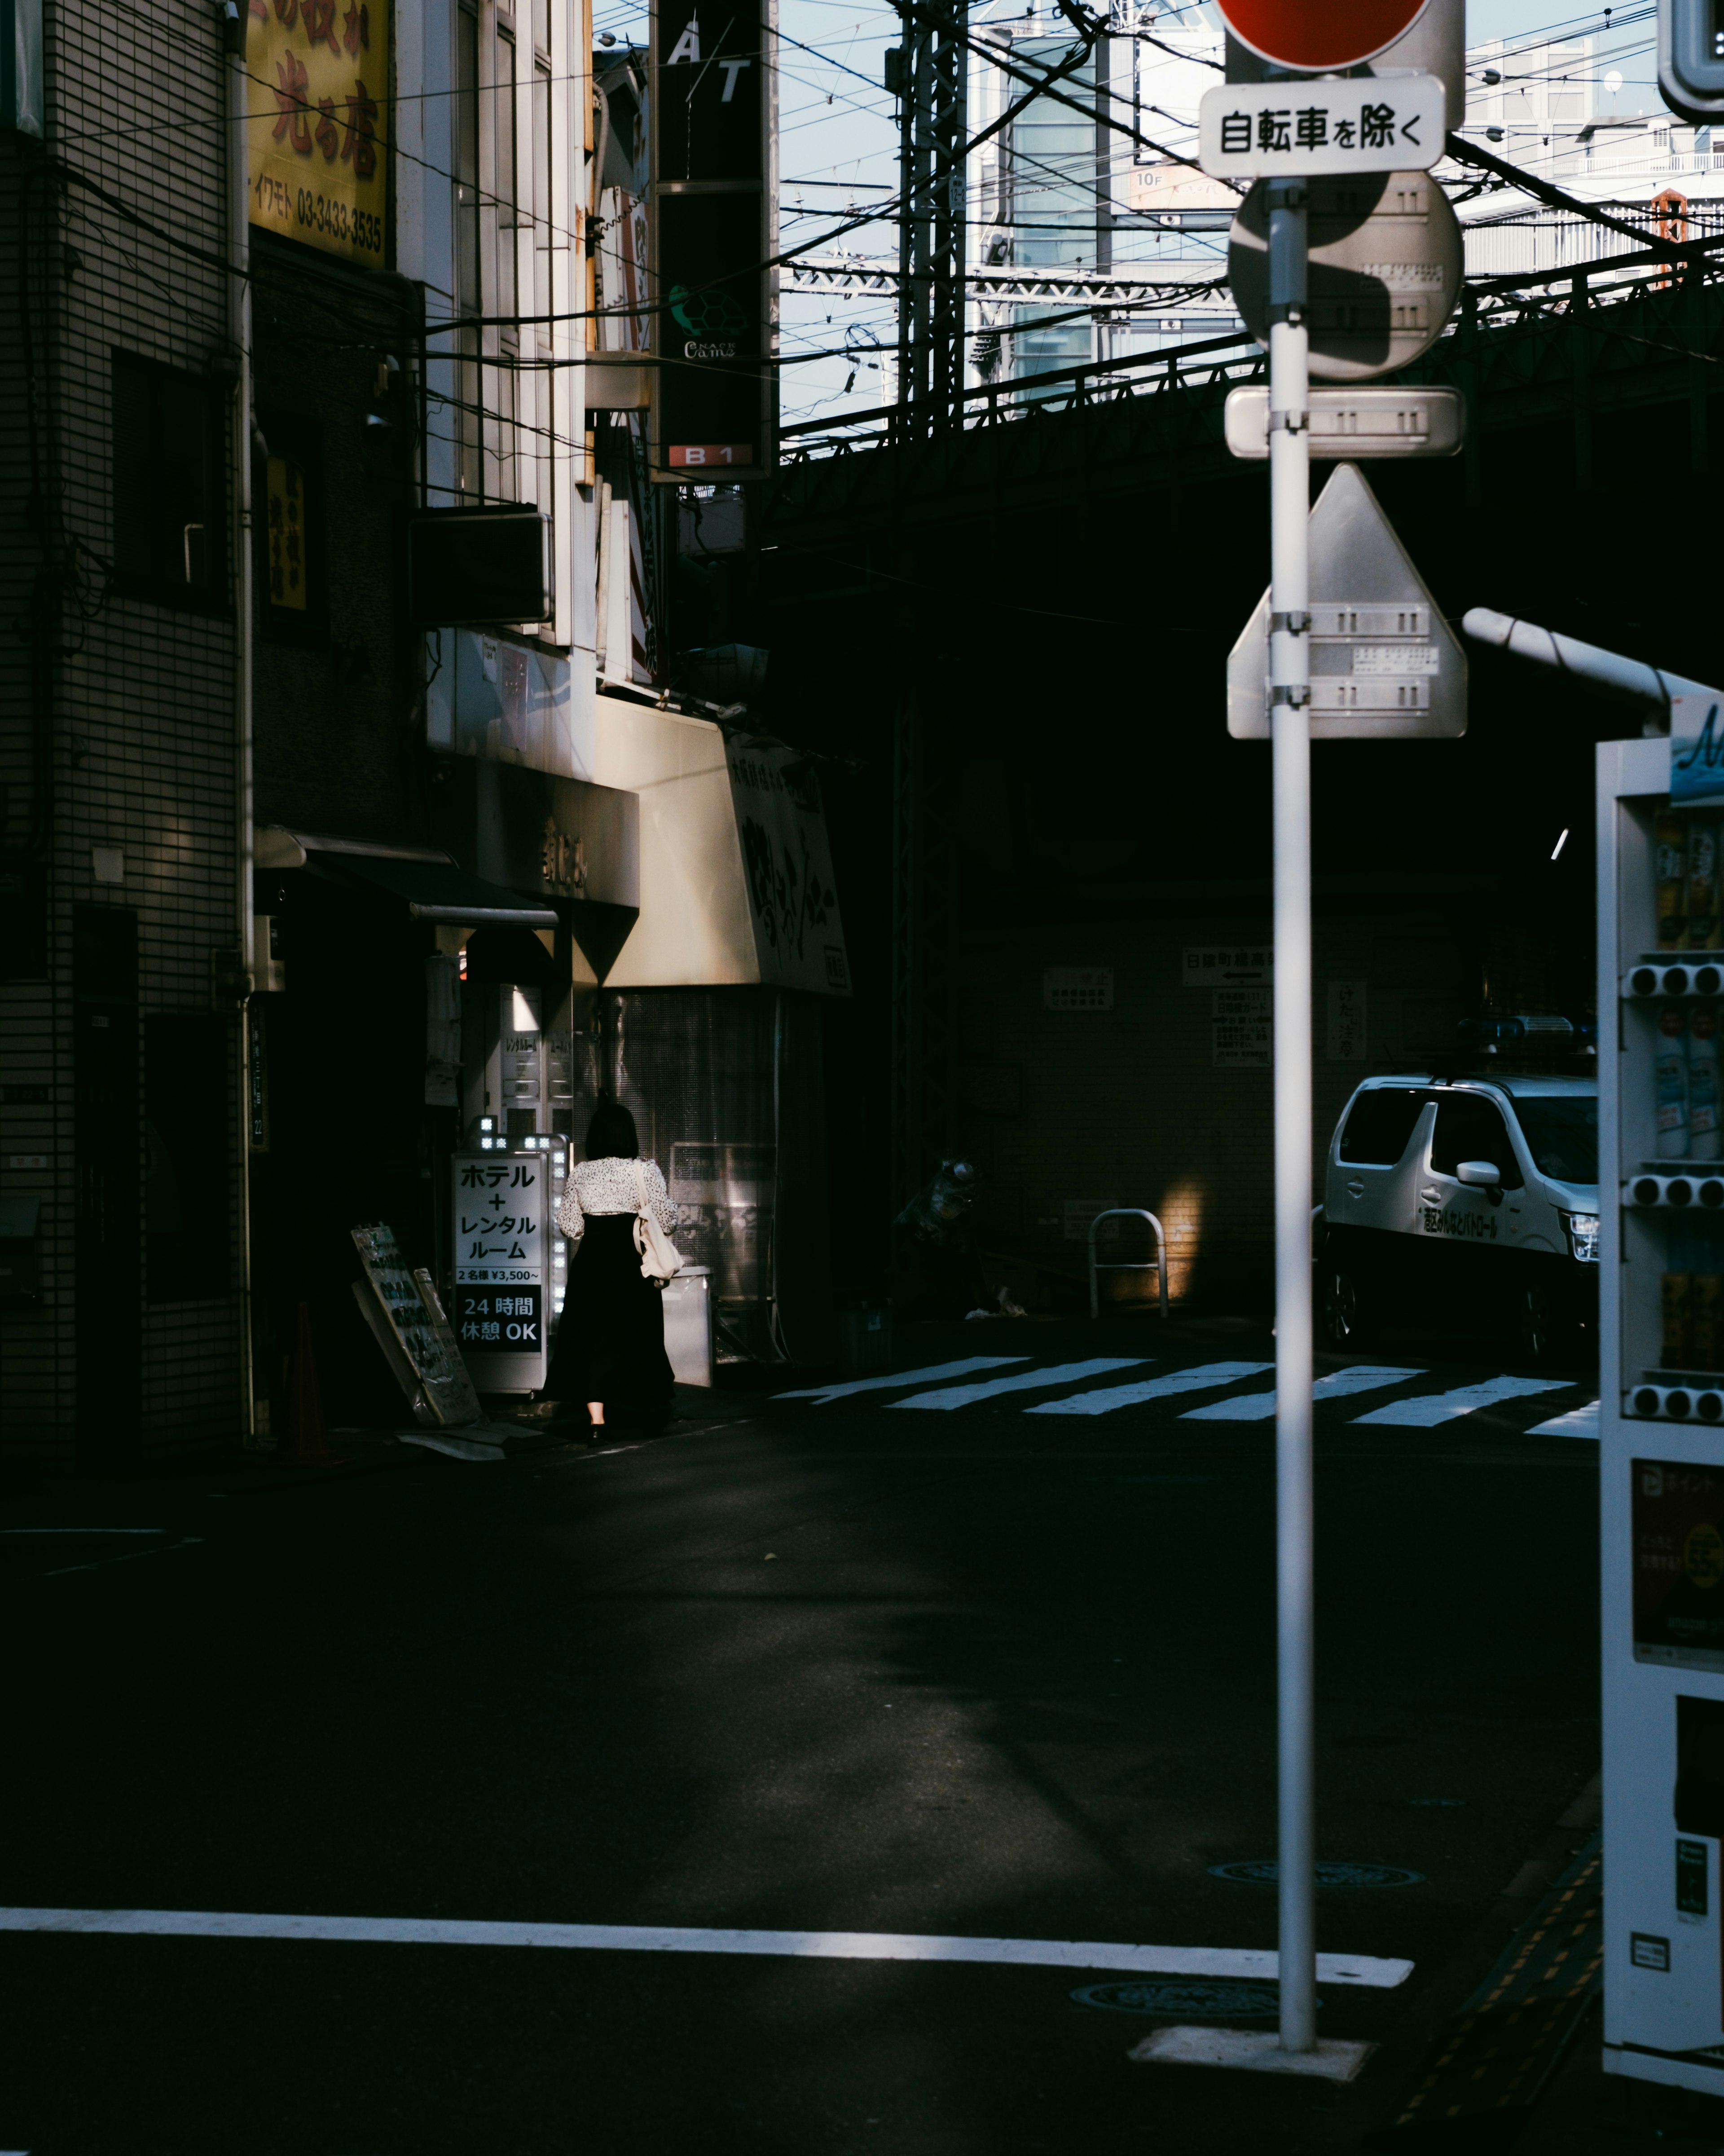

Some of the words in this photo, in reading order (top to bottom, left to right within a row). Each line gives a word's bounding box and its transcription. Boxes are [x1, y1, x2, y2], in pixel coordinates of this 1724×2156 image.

[1221, 103, 1421, 153] 自転車を除く
[951, 189, 965, 201] 12-2
[255, 173, 291, 219] イワモト
[298, 187, 381, 252] 03-3433-3535
[255, 1120, 262, 1134] 22
[461, 1165, 535, 1188] ホテル
[462, 1216, 536, 1234] レンタル
[470, 1242, 526, 1259] ルーム
[465, 1298, 489, 1314] 24
[496, 1297, 533, 1316] 時間
[461, 1321, 500, 1340] 休憩
[506, 1323, 537, 1340] OK
